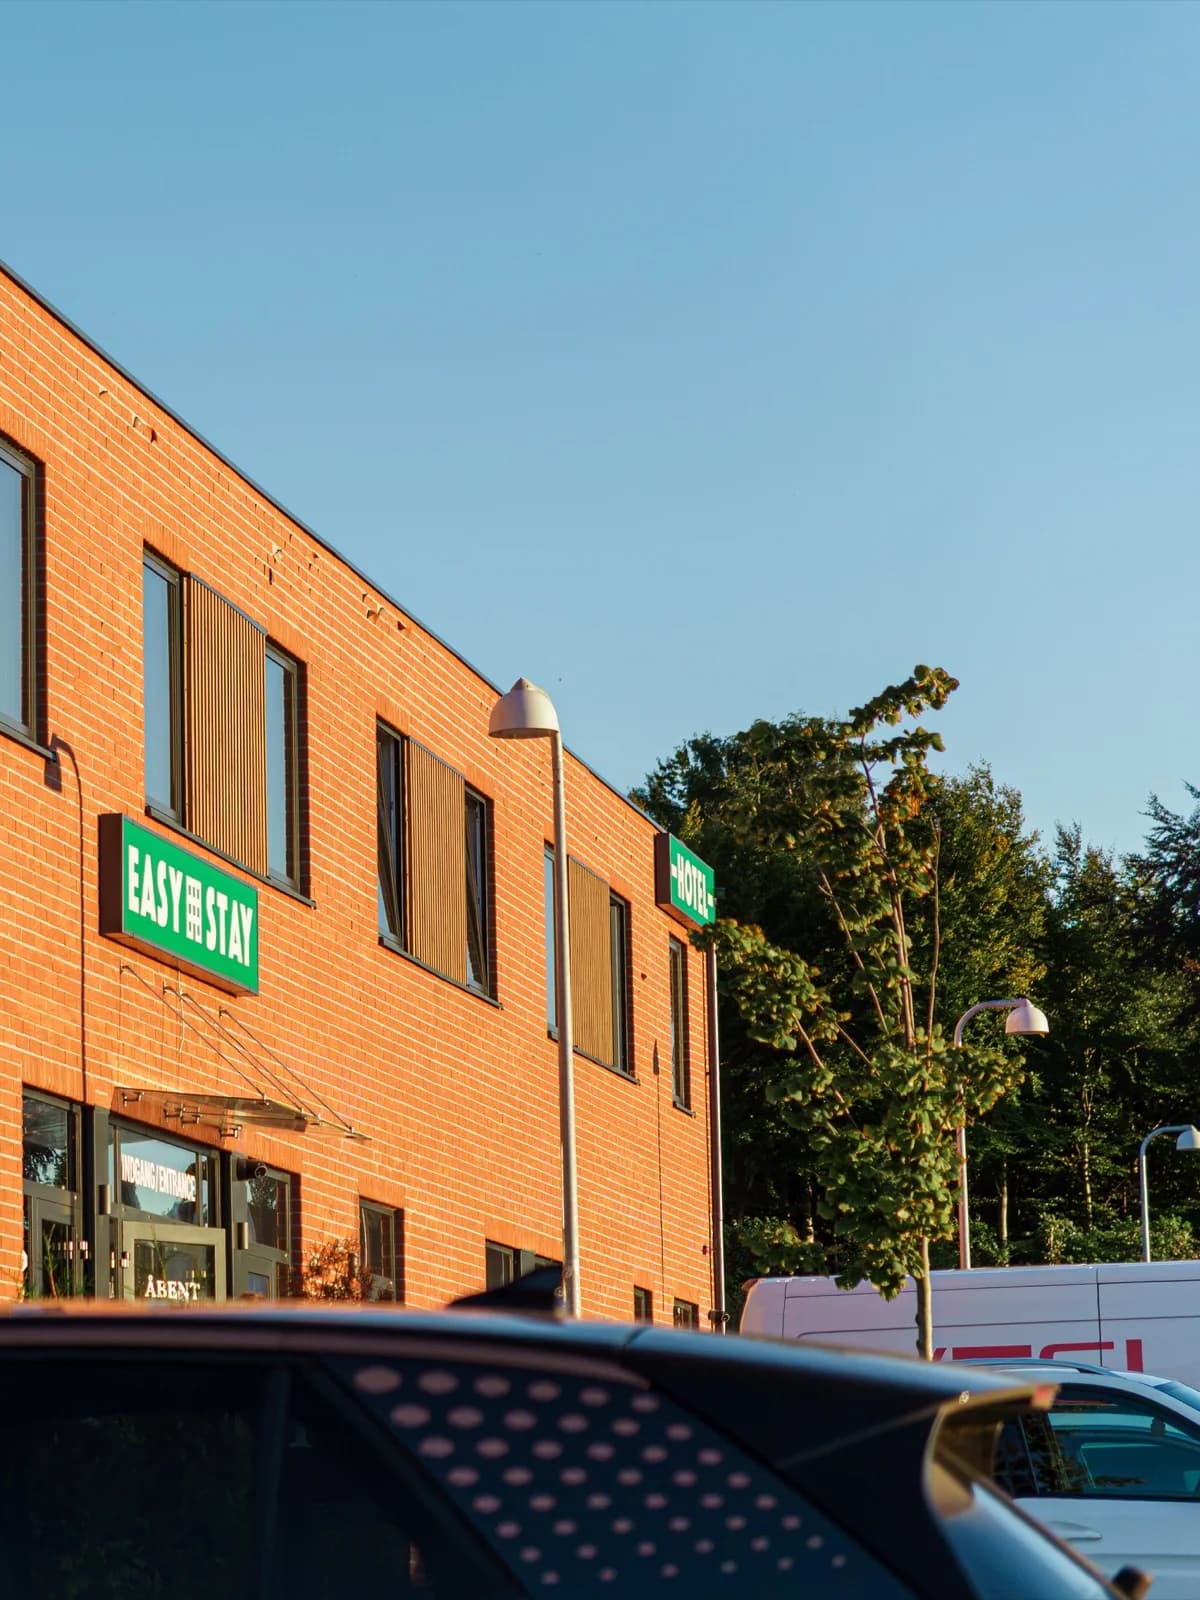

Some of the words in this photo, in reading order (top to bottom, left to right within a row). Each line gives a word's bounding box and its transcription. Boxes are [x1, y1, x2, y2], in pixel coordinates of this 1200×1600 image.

[128, 844, 183, 933] EASY
[206, 886, 253, 967] STAY
[144, 1274, 201, 1302] ÅBENT
